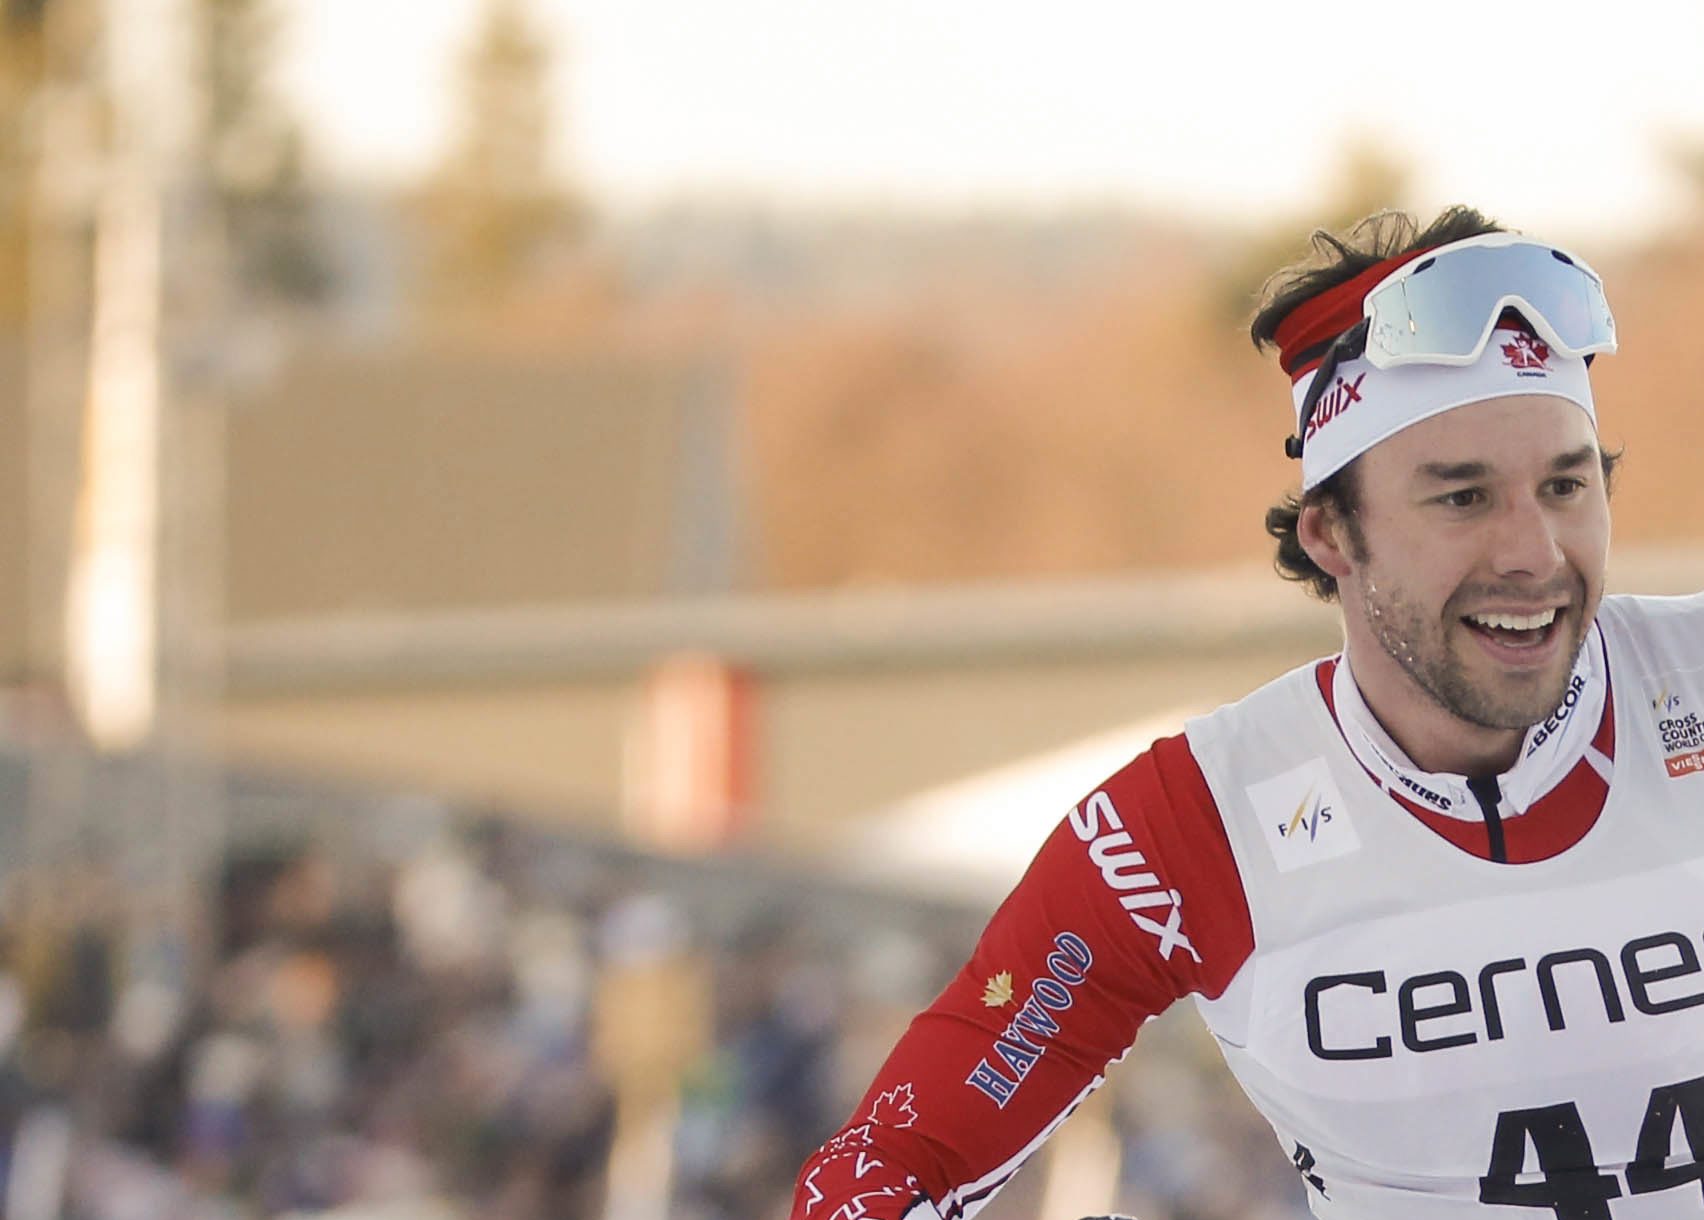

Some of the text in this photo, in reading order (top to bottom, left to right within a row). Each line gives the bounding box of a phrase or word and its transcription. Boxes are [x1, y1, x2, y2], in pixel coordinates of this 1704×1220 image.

[1658, 712, 1698, 732] CROSS
[1663, 737, 1700, 753] WORLD
[964, 931, 1094, 1110] HAYWOOD
